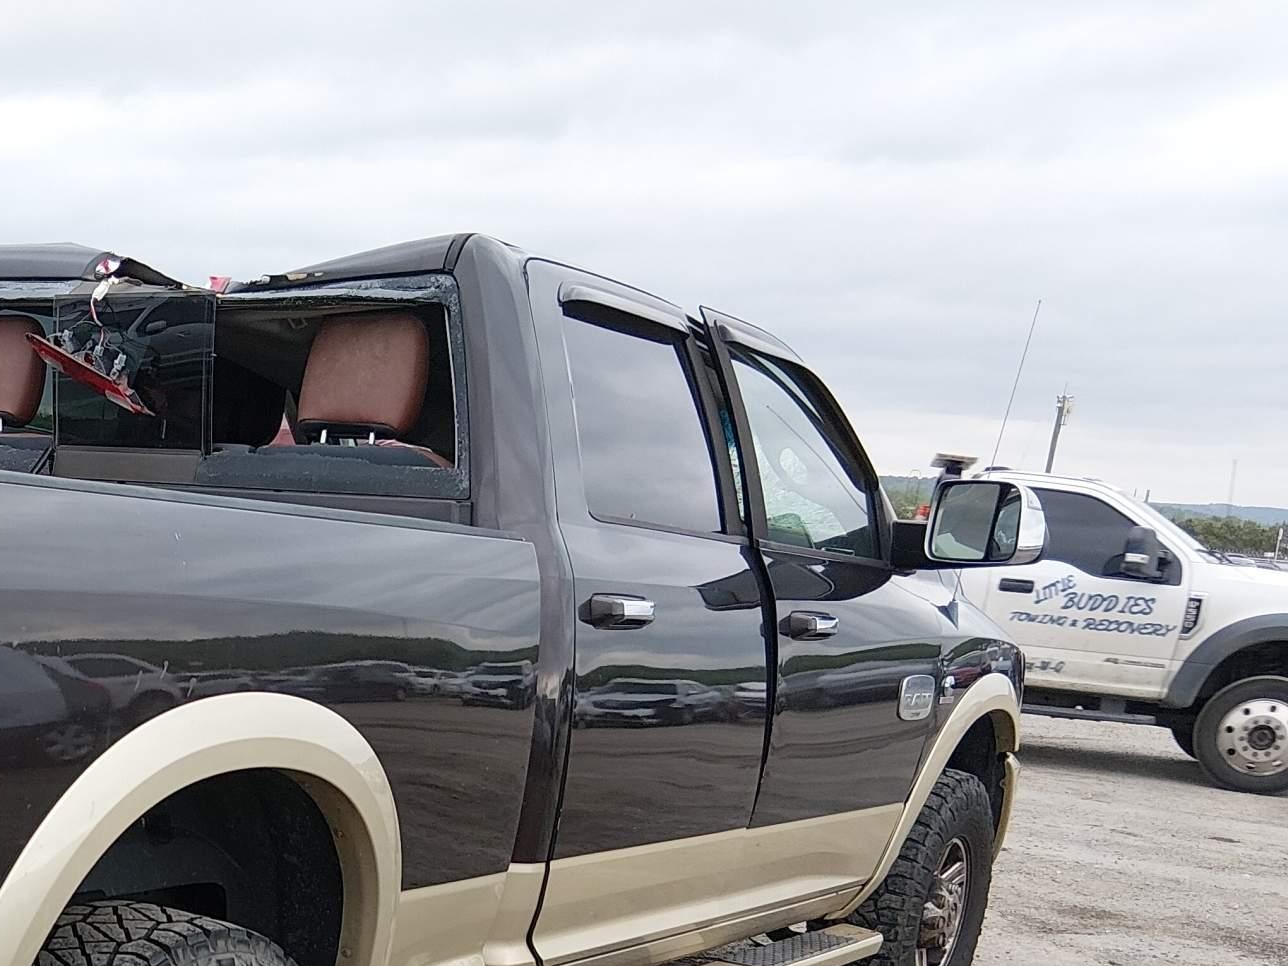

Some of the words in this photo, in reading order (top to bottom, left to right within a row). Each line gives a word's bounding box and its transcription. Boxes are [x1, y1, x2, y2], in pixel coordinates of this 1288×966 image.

[1034, 574, 1077, 604] LITTLE
[1062, 592, 1156, 616] BUDDIES
[1009, 611, 1068, 628] TOWING
[1082, 617, 1177, 638] RECOVERY
